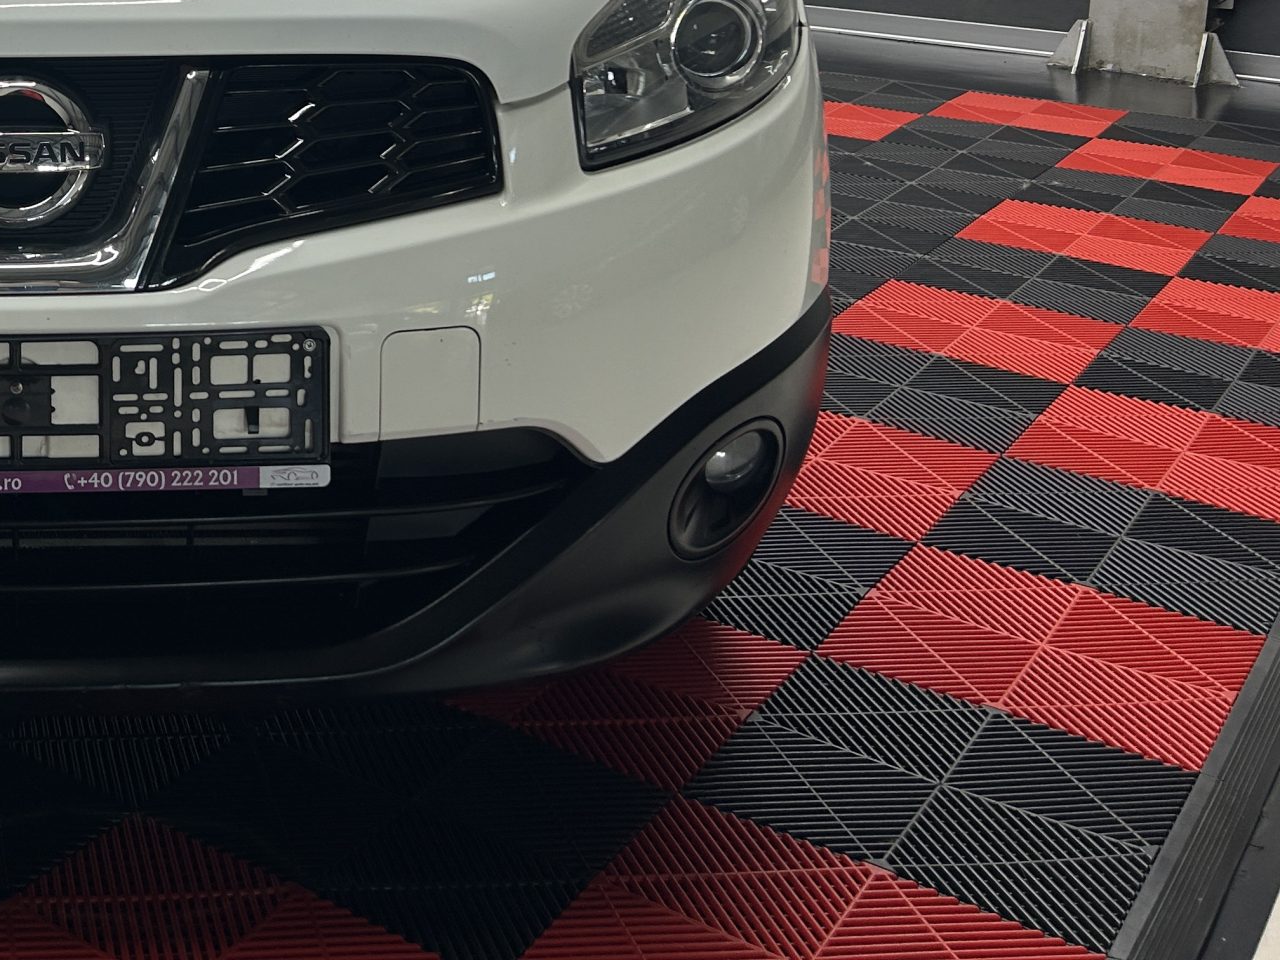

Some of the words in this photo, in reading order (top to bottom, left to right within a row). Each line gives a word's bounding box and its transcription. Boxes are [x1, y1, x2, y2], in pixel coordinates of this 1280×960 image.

[77, 472, 112, 488] +40
[118, 470, 165, 490] (790)
[171, 470, 203, 486] 222
[208, 469, 238, 485] 201
